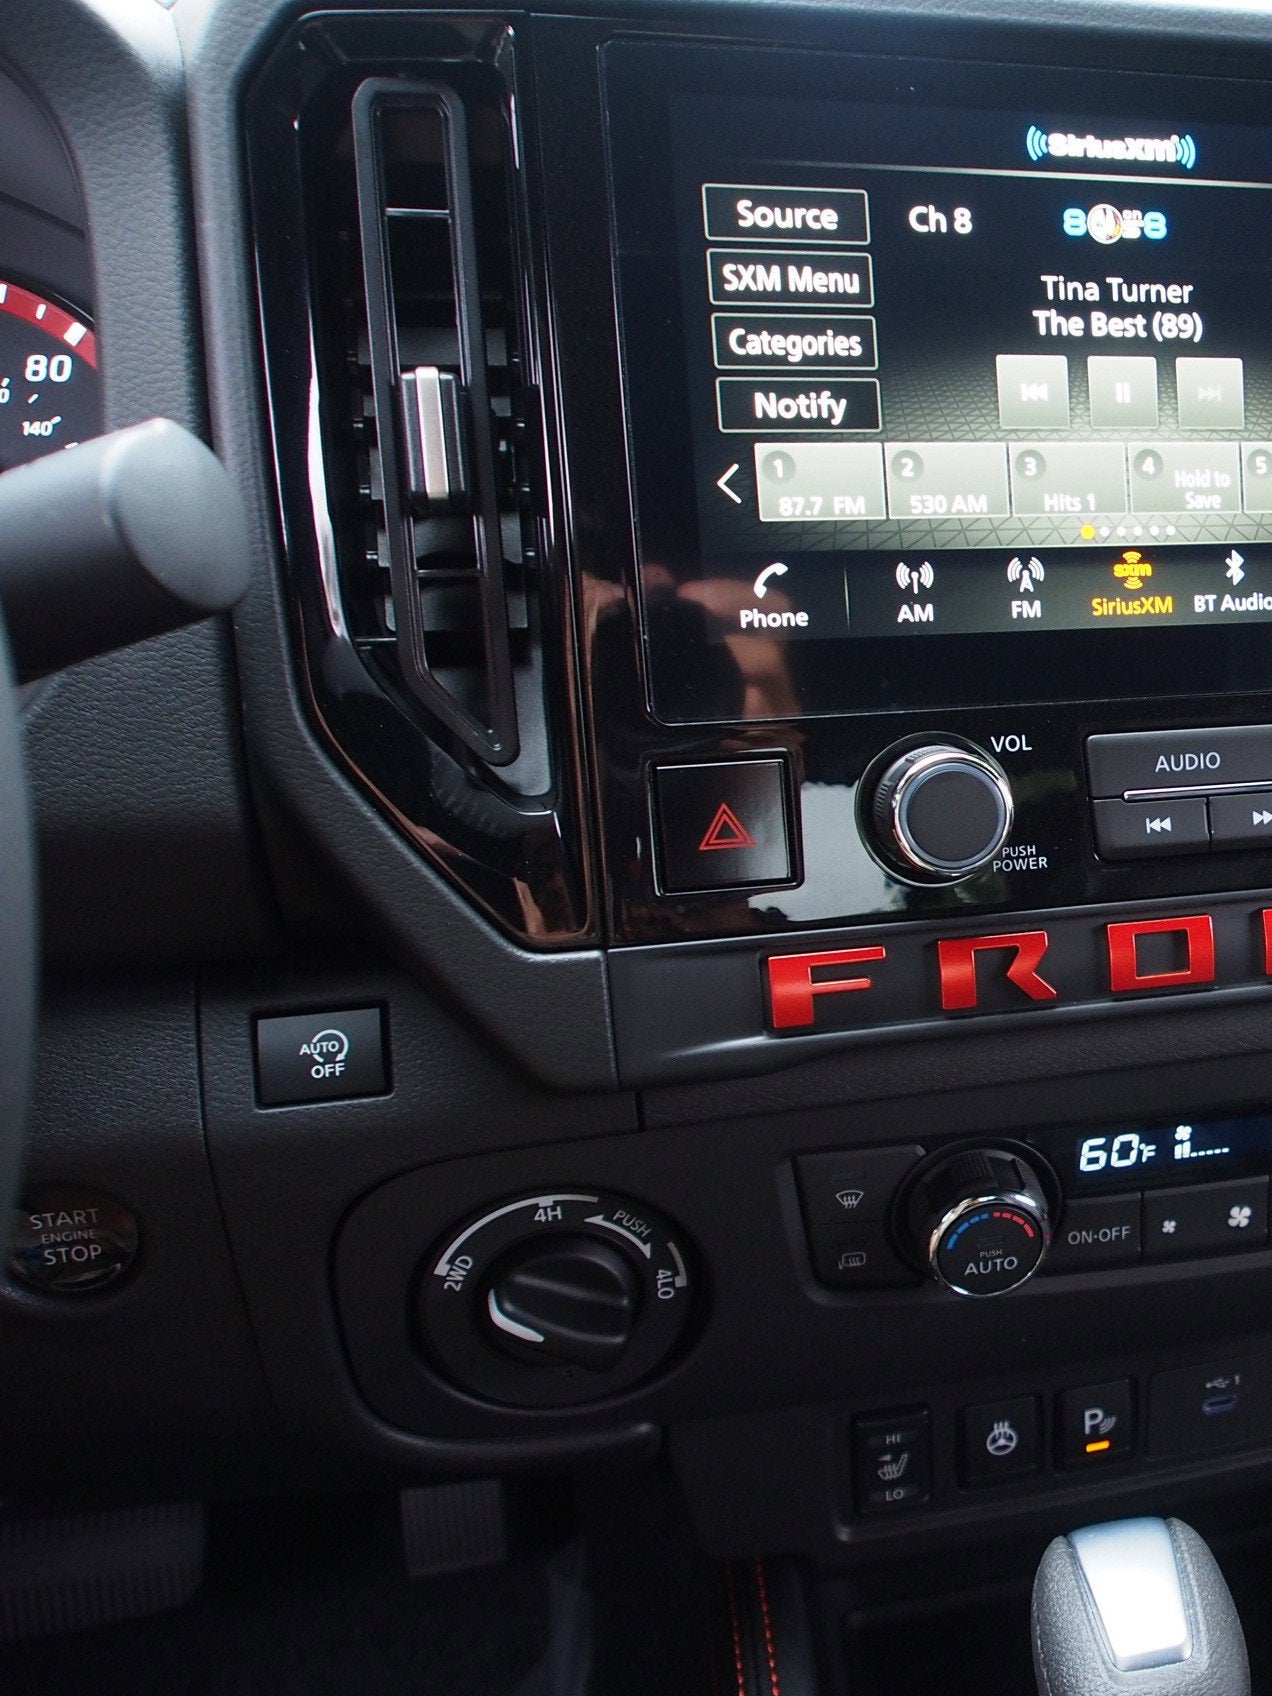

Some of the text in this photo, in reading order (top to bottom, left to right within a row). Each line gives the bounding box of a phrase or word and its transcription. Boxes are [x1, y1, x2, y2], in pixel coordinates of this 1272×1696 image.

[737, 199, 838, 231] Source
[909, 205, 973, 234] Ch 8
[723, 264, 860, 294] SXM Menu
[1041, 275, 1193, 304] Tina Turner
[1032, 309, 1203, 342] The Best (89)
[729, 328, 862, 362] Categories
[25, 354, 72, 382] 80
[754, 391, 847, 424] Notify
[22, 421, 53, 436] 140
[773, 459, 783, 478] 1
[901, 457, 914, 477] 2
[1024, 457, 1038, 475] 3
[1142, 456, 1155, 474] 4
[1255, 456, 1267, 474] 5
[1174, 470, 1230, 489] Hold to
[779, 495, 866, 517] 87.7 FM
[909, 495, 988, 514] 530 AM
[1044, 493, 1096, 512] Hits 1
[1185, 492, 1222, 510] Save
[897, 604, 934, 623] AM
[1011, 601, 1041, 620] FM
[1091, 597, 1173, 617] SiriusXM
[1194, 595, 1217, 613] BT
[740, 608, 809, 630] Phone
[990, 734, 1032, 752] VOL
[1155, 751, 1221, 773] AUDIO
[1002, 845, 1036, 858] PUSH
[993, 857, 1048, 872] POWER
[299, 1040, 339, 1056] AUTO
[310, 1062, 345, 1079] OFF
[29, 1207, 99, 1230] START
[534, 1206, 562, 1223] 4H
[613, 1210, 651, 1238] PUSH
[41, 1229, 97, 1244] ENGINE
[44, 1244, 102, 1266] STOP
[980, 1249, 1003, 1258] PUSH
[444, 1254, 474, 1292] 2WD
[964, 1256, 1018, 1277] AUTO
[656, 1268, 678, 1300] 4LO
[886, 1434, 900, 1445] HI
[886, 1489, 904, 1501] LO
